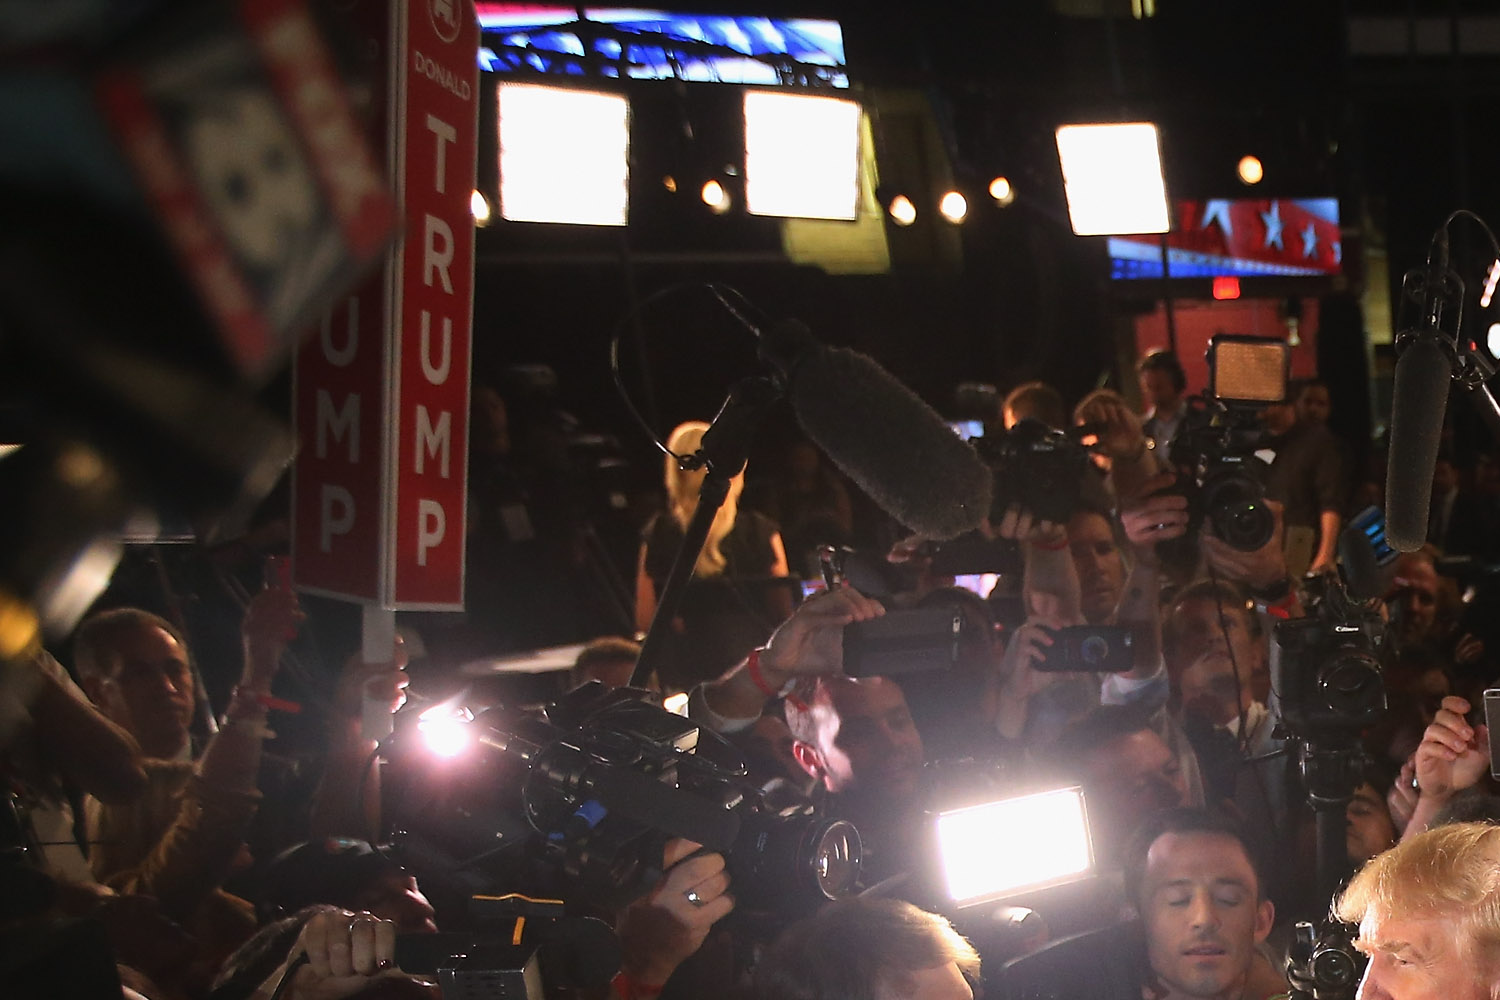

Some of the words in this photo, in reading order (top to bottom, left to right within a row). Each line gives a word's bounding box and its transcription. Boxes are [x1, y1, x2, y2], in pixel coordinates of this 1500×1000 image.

[415, 51, 471, 101] DONALD
[316, 299, 360, 552] UMP
[415, 113, 457, 567] TRUMP
